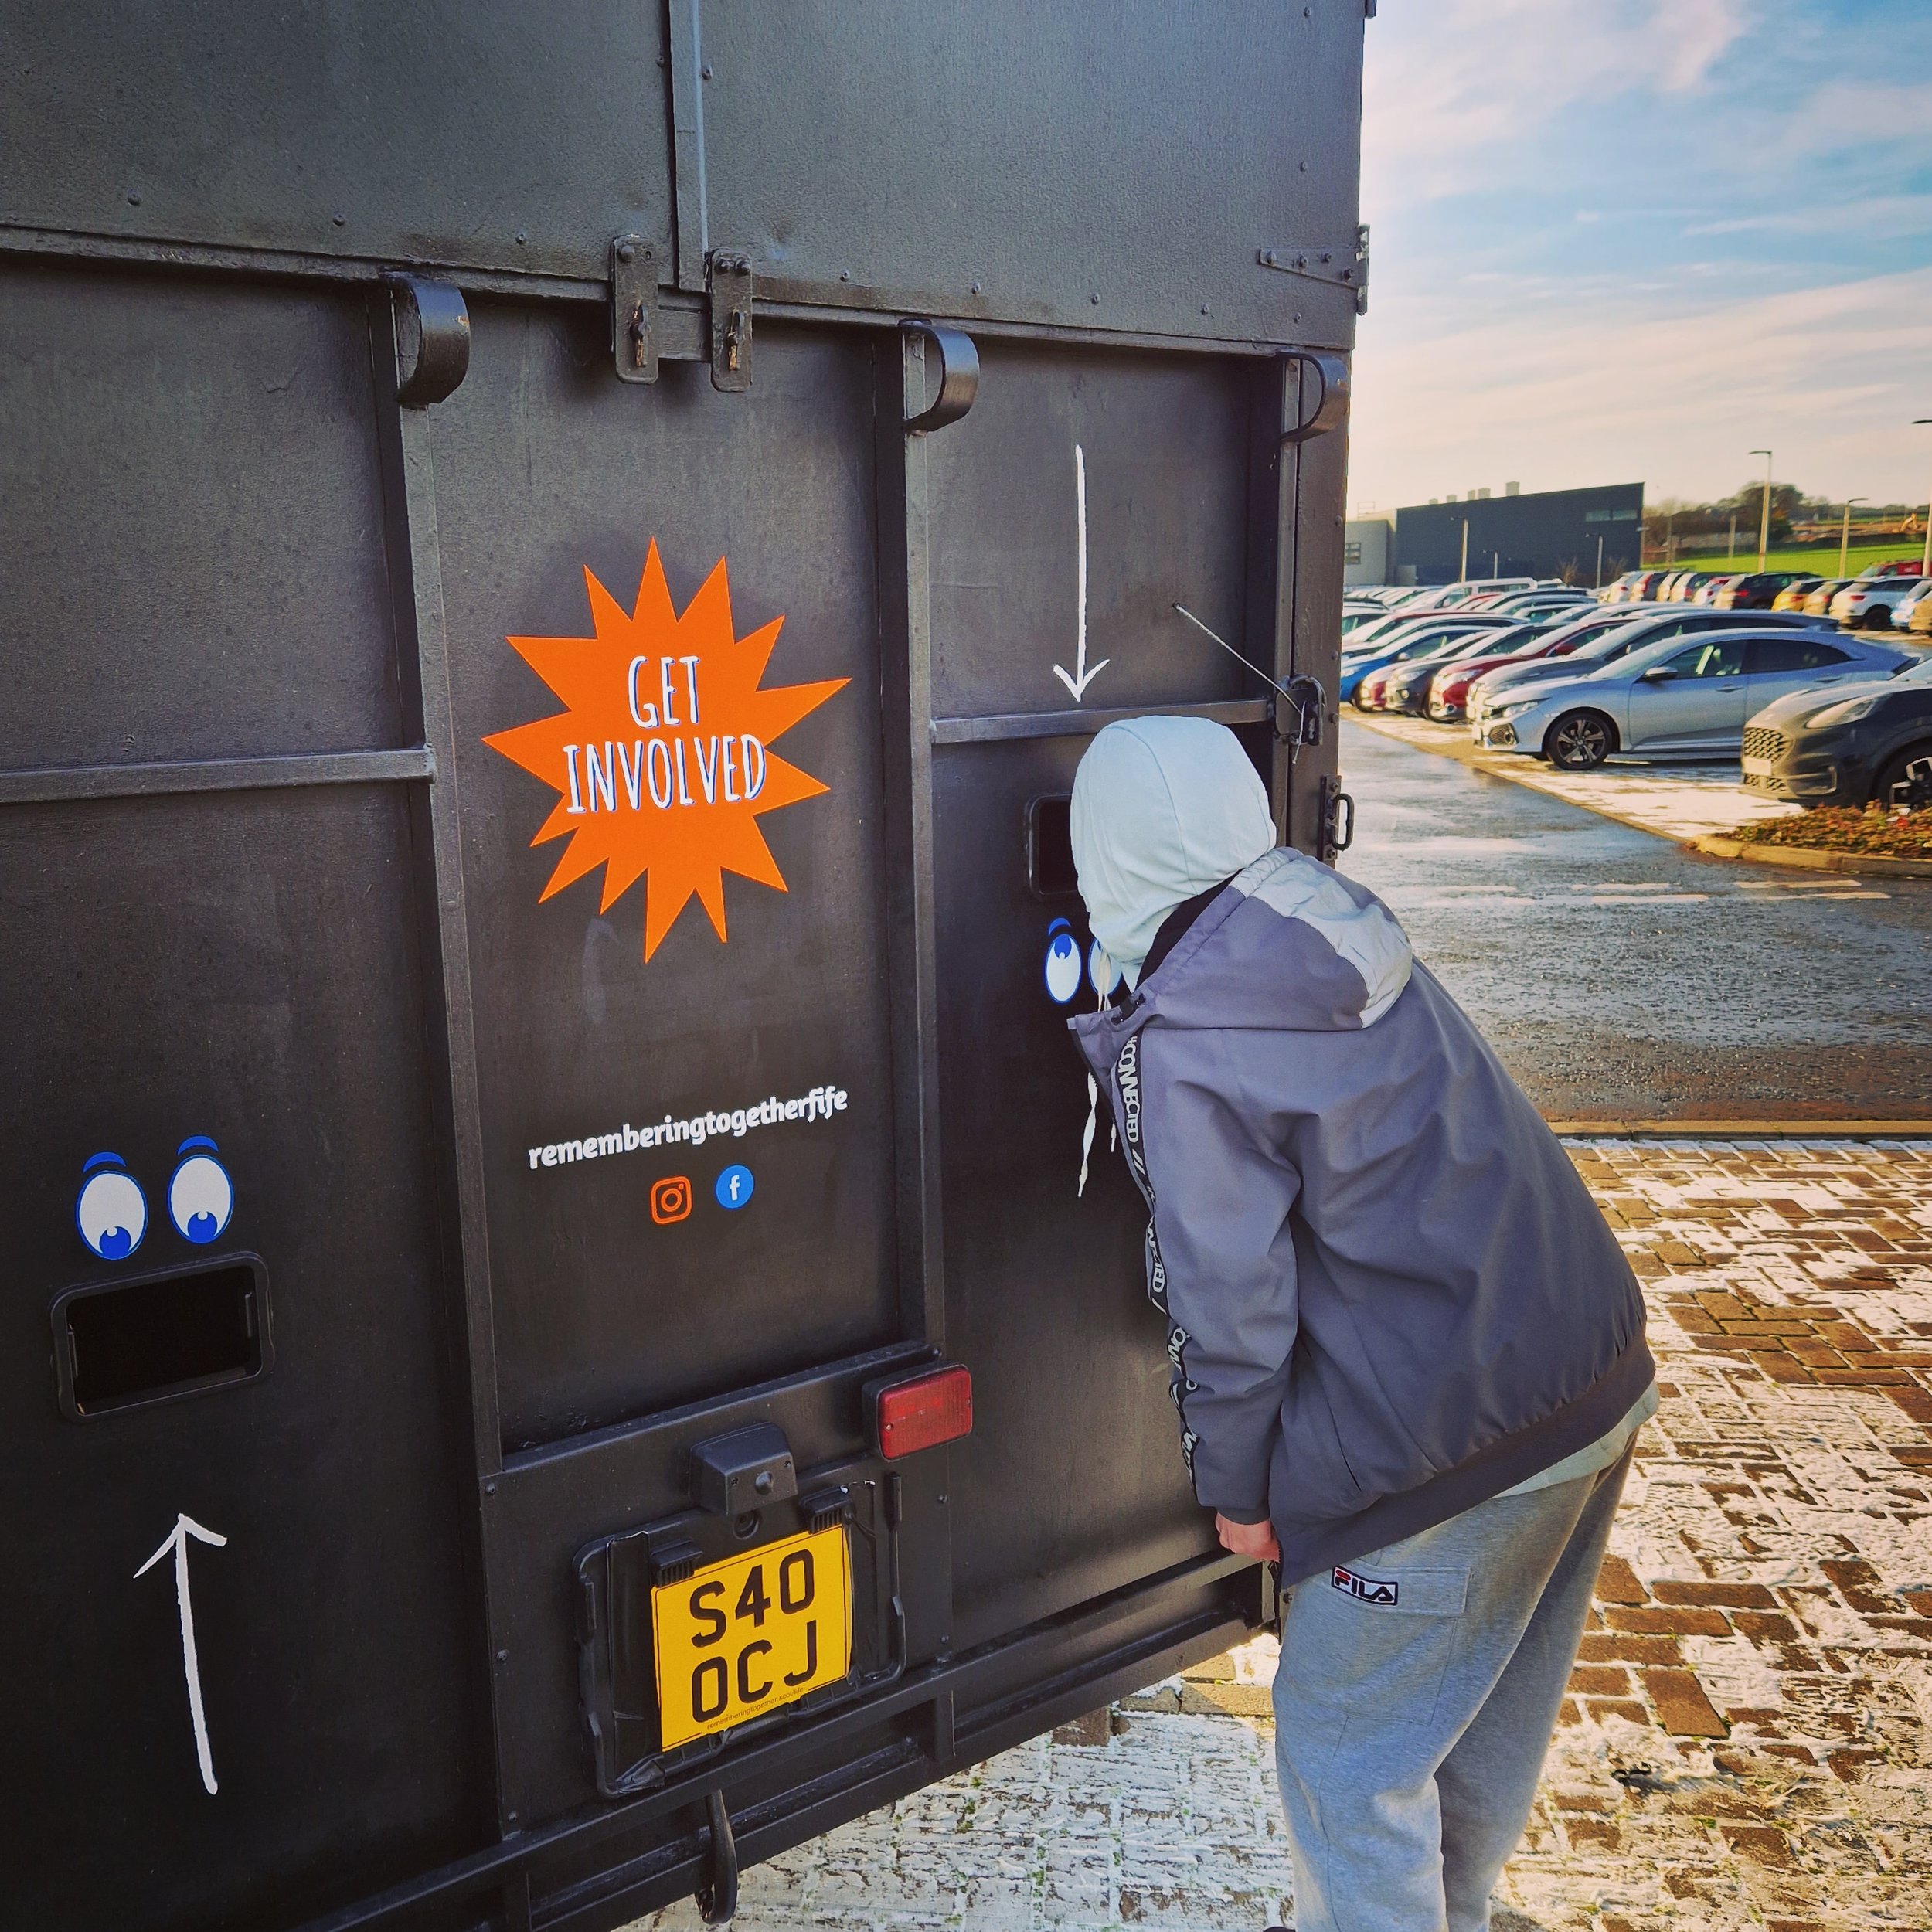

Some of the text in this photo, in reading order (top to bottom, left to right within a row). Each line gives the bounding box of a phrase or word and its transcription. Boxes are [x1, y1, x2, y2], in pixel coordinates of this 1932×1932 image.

[628, 655, 701, 728] GET
[563, 734, 767, 814] INVOLVED
[528, 1085, 849, 1170] rememberingtogetherfife
[689, 1548, 815, 1648] S40
[1335, 1570, 1394, 1602] FILA
[691, 1619, 818, 1723] OCJ
